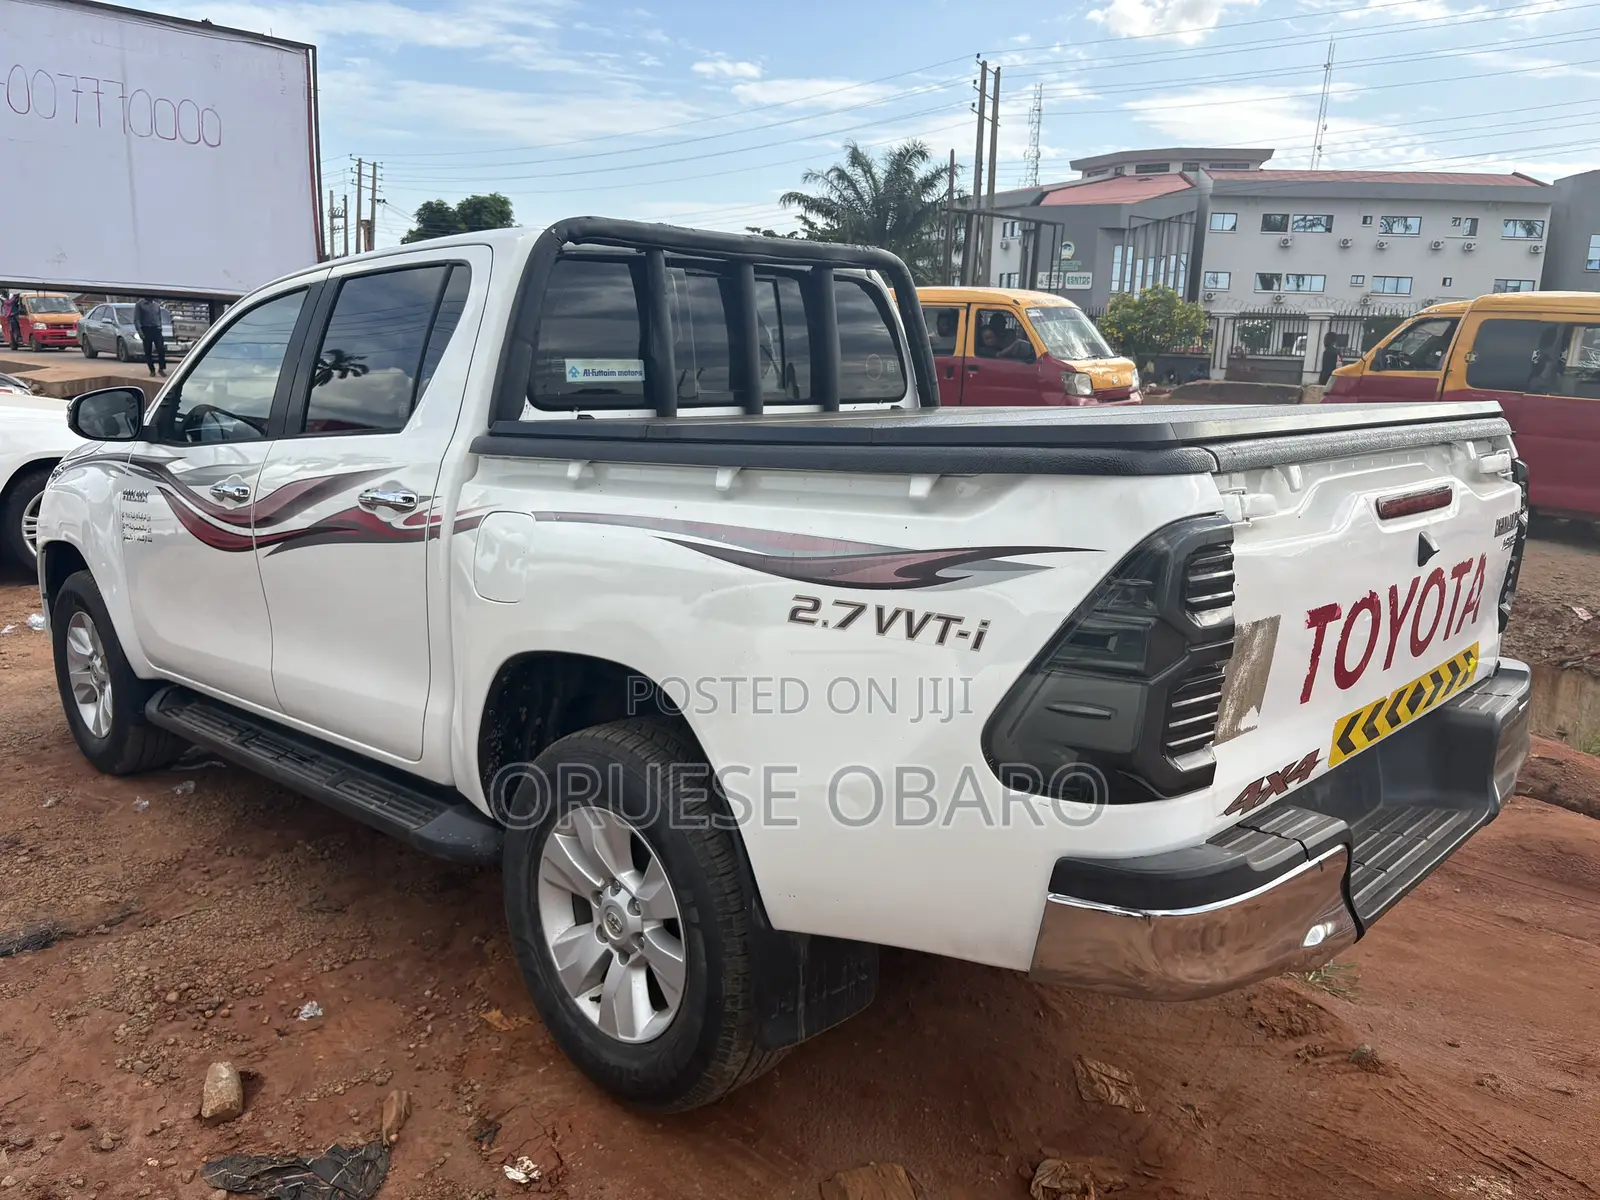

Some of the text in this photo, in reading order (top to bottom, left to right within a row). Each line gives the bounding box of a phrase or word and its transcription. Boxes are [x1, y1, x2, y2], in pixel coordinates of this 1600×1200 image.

[0, 64, 222, 148] 007770000
[583, 368, 643, 377] Al-Futtaim motors
[787, 594, 992, 652] 2.7 VVT-i
[1300, 552, 1487, 704] TOYOTA
